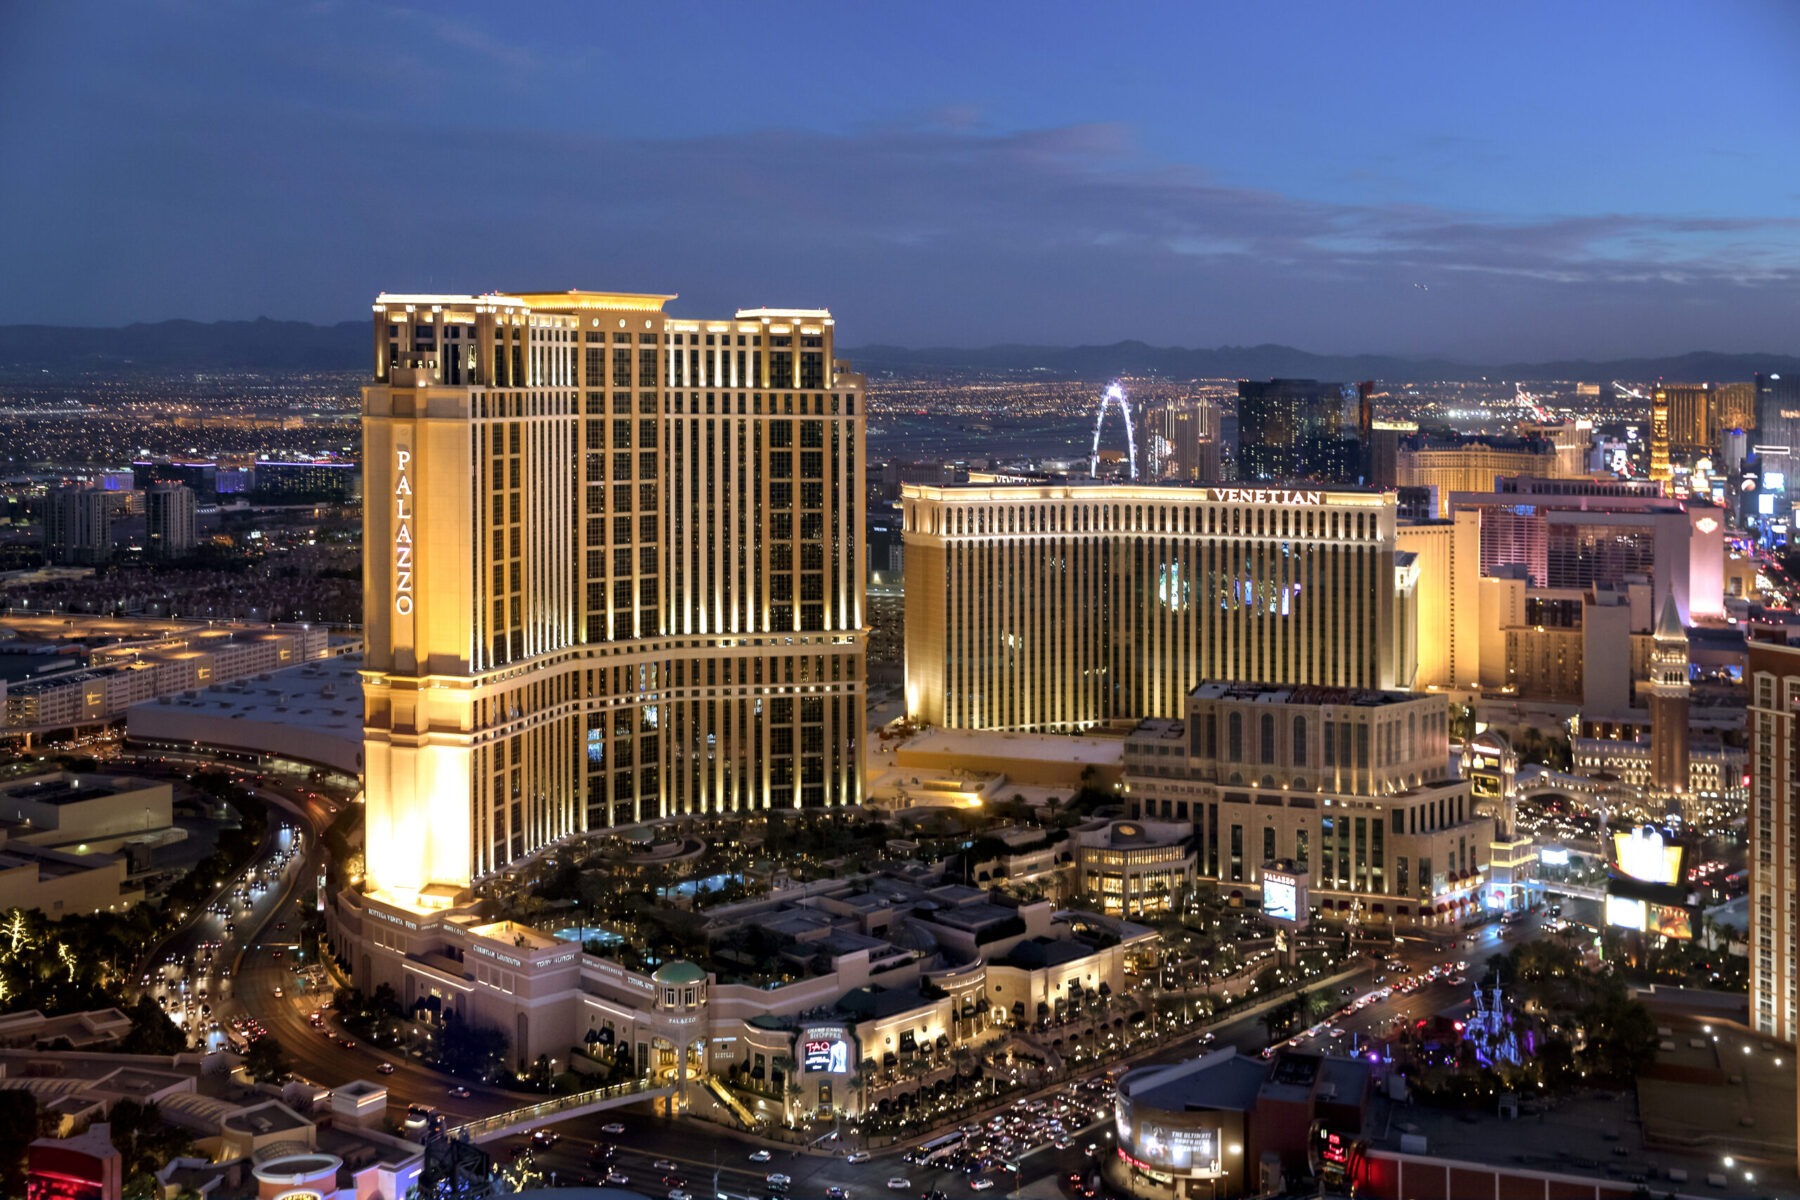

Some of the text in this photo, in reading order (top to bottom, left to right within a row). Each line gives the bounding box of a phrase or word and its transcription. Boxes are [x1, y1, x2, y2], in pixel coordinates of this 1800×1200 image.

[1212, 488, 1322, 505] VENETIAN
[396, 451, 413, 615] PALAZZO
[1264, 872, 1296, 886] PALAZZO
[805, 1041, 830, 1054] TAO
